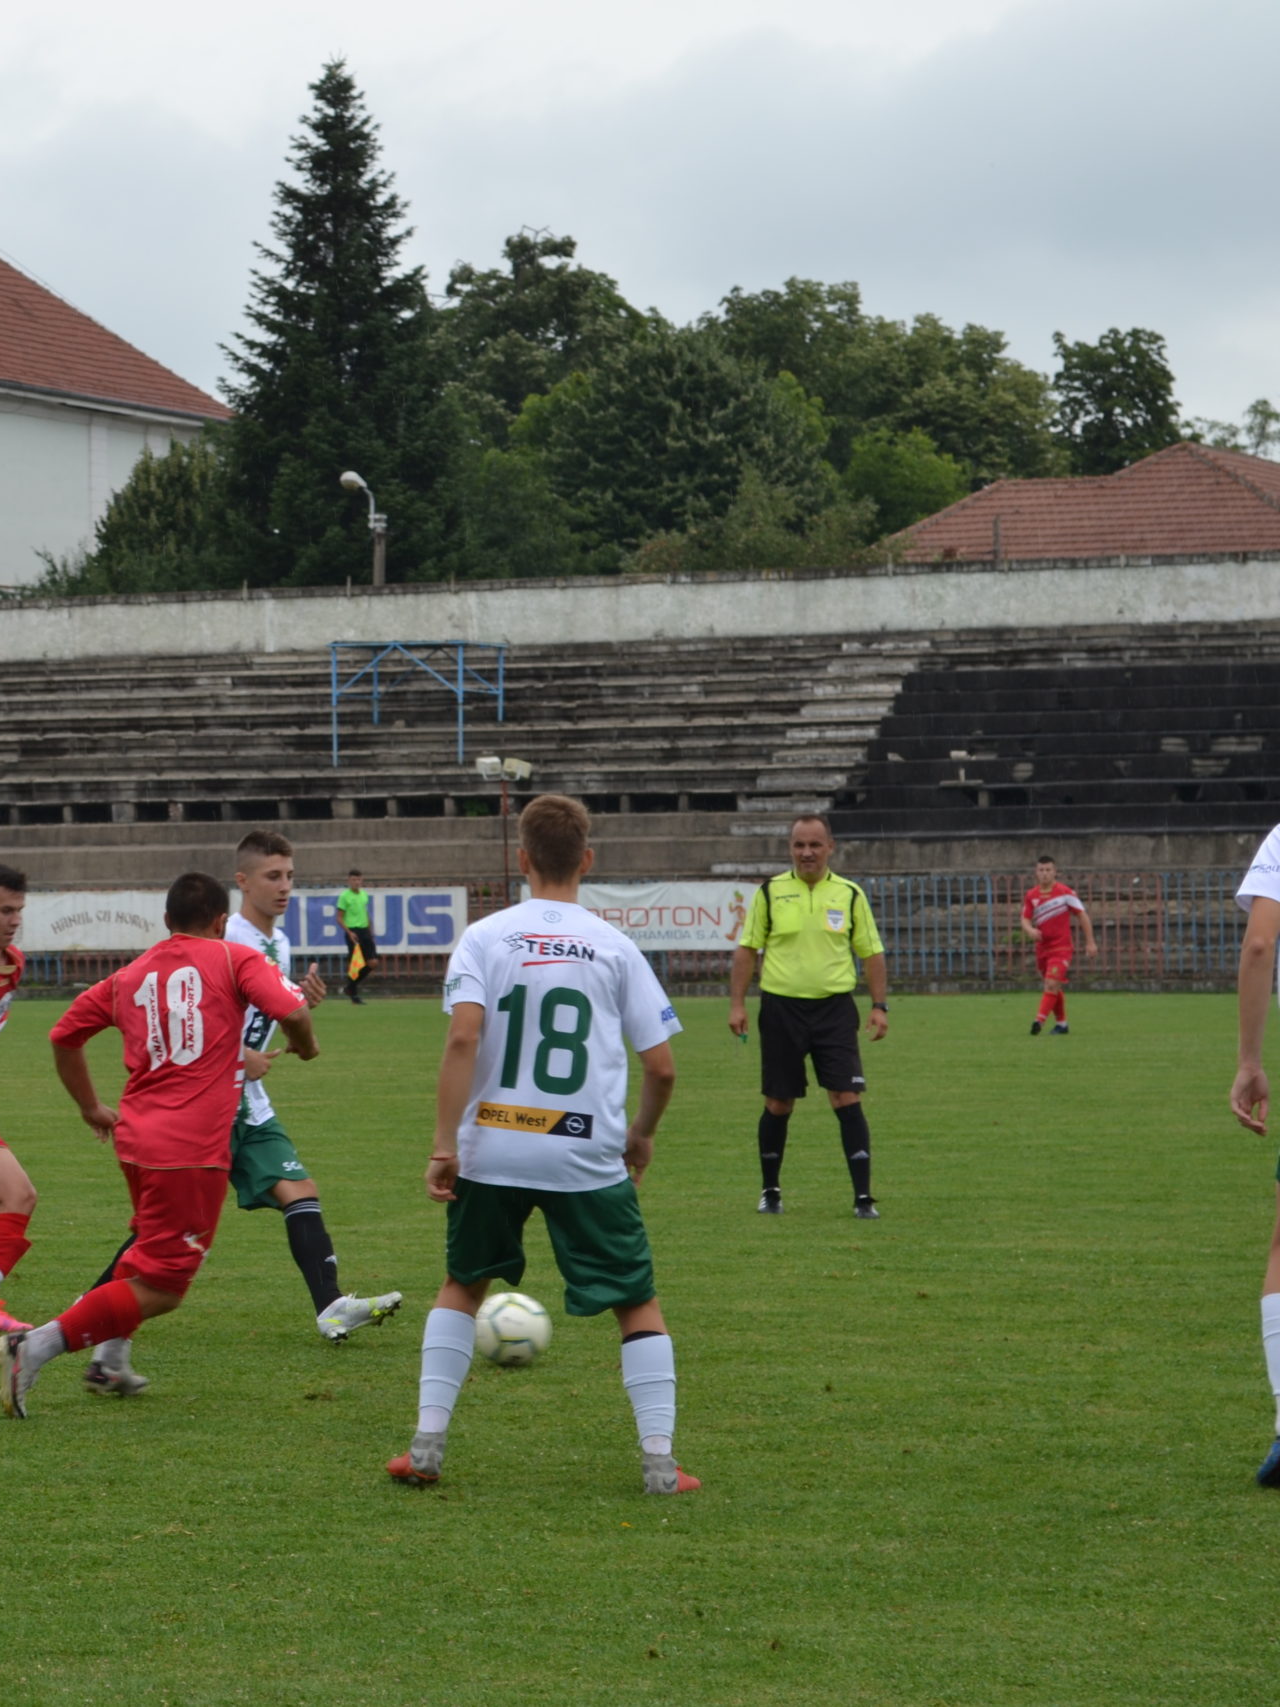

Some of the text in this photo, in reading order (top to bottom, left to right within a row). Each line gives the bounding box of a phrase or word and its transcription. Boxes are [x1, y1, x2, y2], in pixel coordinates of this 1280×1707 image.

[525, 939, 595, 961] TESAN
[133, 966, 203, 1072] 18
[497, 983, 592, 1095] 18
[480, 1108, 547, 1127] OPEL West
